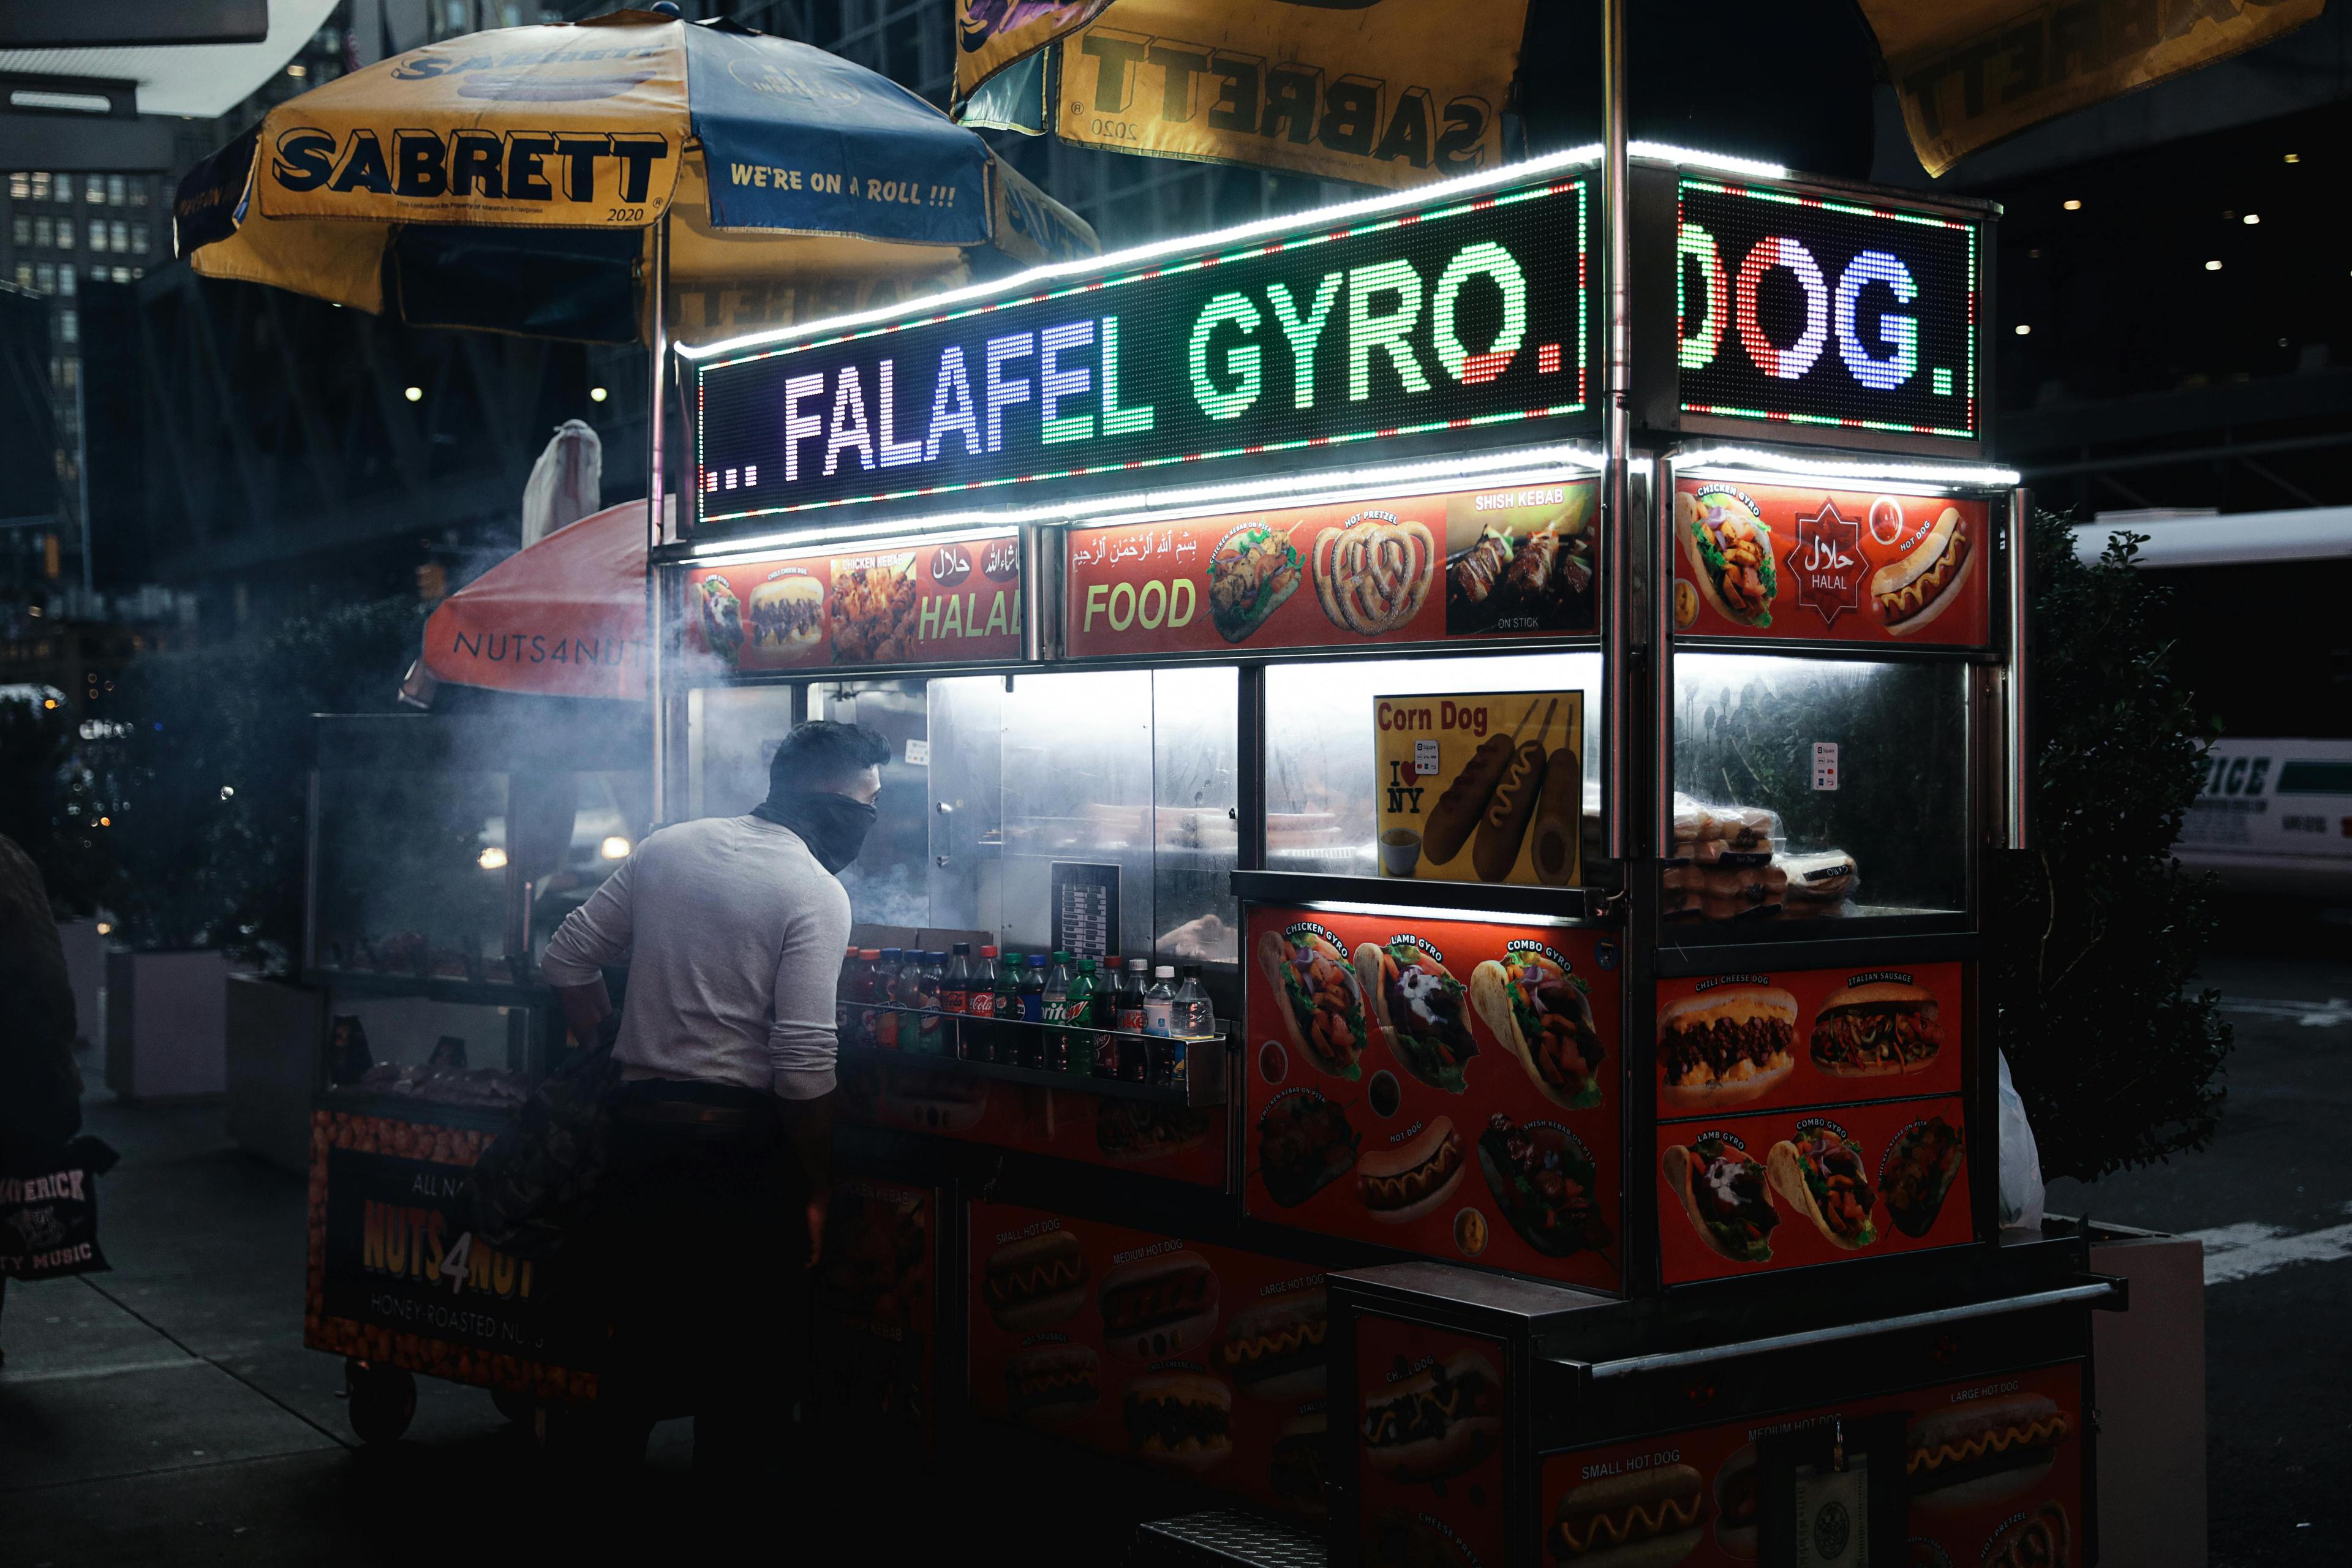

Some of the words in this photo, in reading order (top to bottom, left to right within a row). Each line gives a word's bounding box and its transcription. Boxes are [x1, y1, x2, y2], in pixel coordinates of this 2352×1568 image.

[273, 127, 668, 203] SABRETT
[731, 162, 802, 190] WE'RE
[810, 173, 841, 194] ON
[867, 178, 921, 205] ROLL
[607, 208, 644, 222] 2020
[785, 317, 1155, 482] FALAFEL
[1475, 494, 1513, 511] SHISH
[1518, 488, 1564, 508] KEBAB
[1697, 484, 1737, 498] CHICKEN
[1738, 490, 1760, 518] GYRO
[1344, 514, 1362, 528] HOT
[1363, 510, 1398, 526] PRETZEL
[1209, 533, 1230, 565] CHICKEN
[1229, 522, 1248, 537] KEBAB
[1258, 522, 1272, 533] PITA
[1900, 537, 1918, 552] HOT
[1917, 519, 1932, 537] DOG
[841, 557, 875, 571] CHICKEN
[876, 554, 904, 568] KEBAB
[1804, 535, 1854, 571] حلال
[1812, 574, 1847, 590] HALAL
[918, 589, 1020, 640] HALAL
[1084, 578, 1196, 633] FOOD
[1498, 618, 1510, 629] ON
[1513, 617, 1539, 628] STICK
[1378, 702, 1431, 731] Corn
[1441, 701, 1487, 737] Dog
[1390, 760, 1400, 787] I
[1387, 788, 1424, 813] NY
[1286, 921, 1324, 936] CHICKEN
[1326, 930, 1348, 959] GYRO
[1391, 934, 1416, 945] LAMB
[1419, 937, 1443, 963] GYRO
[1507, 939, 1543, 953] COMBO
[1545, 946, 1571, 973] GYRO
[1695, 978, 1718, 992] CHILI
[1721, 974, 1749, 986] CHEESE
[1752, 974, 1769, 985] DOG
[1848, 973, 1877, 986] ITALIAN
[1880, 972, 1912, 983] SAUSAGE
[1261, 1095, 1281, 1121] CHICKEN
[1281, 1087, 1300, 1097] KEBAB
[1312, 1090, 1326, 1103] PITA
[1390, 1131, 1404, 1144] HOT
[1405, 1120, 1422, 1139] DOG
[1697, 1131, 1721, 1143] LAMB
[1722, 1132, 1744, 1150] GYRO
[1796, 1118, 1825, 1130] COMBO
[1826, 1121, 1847, 1138] GYRO
[1523, 1120, 1546, 1131] SHISH
[1548, 1120, 1571, 1136] KEBAB
[1572, 1134, 1583, 1146] ON
[1583, 1146, 1596, 1169] PITA
[412, 1174, 437, 1197] ALL
[996, 1227, 1022, 1245] SMALL
[1023, 1223, 1041, 1238] HOT
[1042, 1218, 1061, 1234] DOG
[32, 1242, 92, 1269] MUSIC
[1113, 1246, 1145, 1265] MEDIUM
[1146, 1242, 1163, 1258] HOT
[1164, 1238, 1183, 1253] DOG
[1260, 1281, 1286, 1297] LARGE
[1287, 1277, 1304, 1291] HOT
[1306, 1273, 1324, 1287] DOG
[371, 1292, 495, 1338] HONEY-ROASTED
[1414, 1355, 1434, 1373] DOG
[1950, 1387, 1980, 1403] LARGE
[1981, 1384, 1999, 1396] HOT
[2000, 1380, 2019, 1393] DOG
[1581, 1460, 1623, 1480] SMALL
[1626, 1454, 1651, 1471] HOT
[1654, 1449, 1680, 1466] DOG
[1418, 1512, 1454, 1539] CHEESE
[1980, 1535, 1994, 1558] HOT
[1994, 1510, 2027, 1537] PRETZEL
